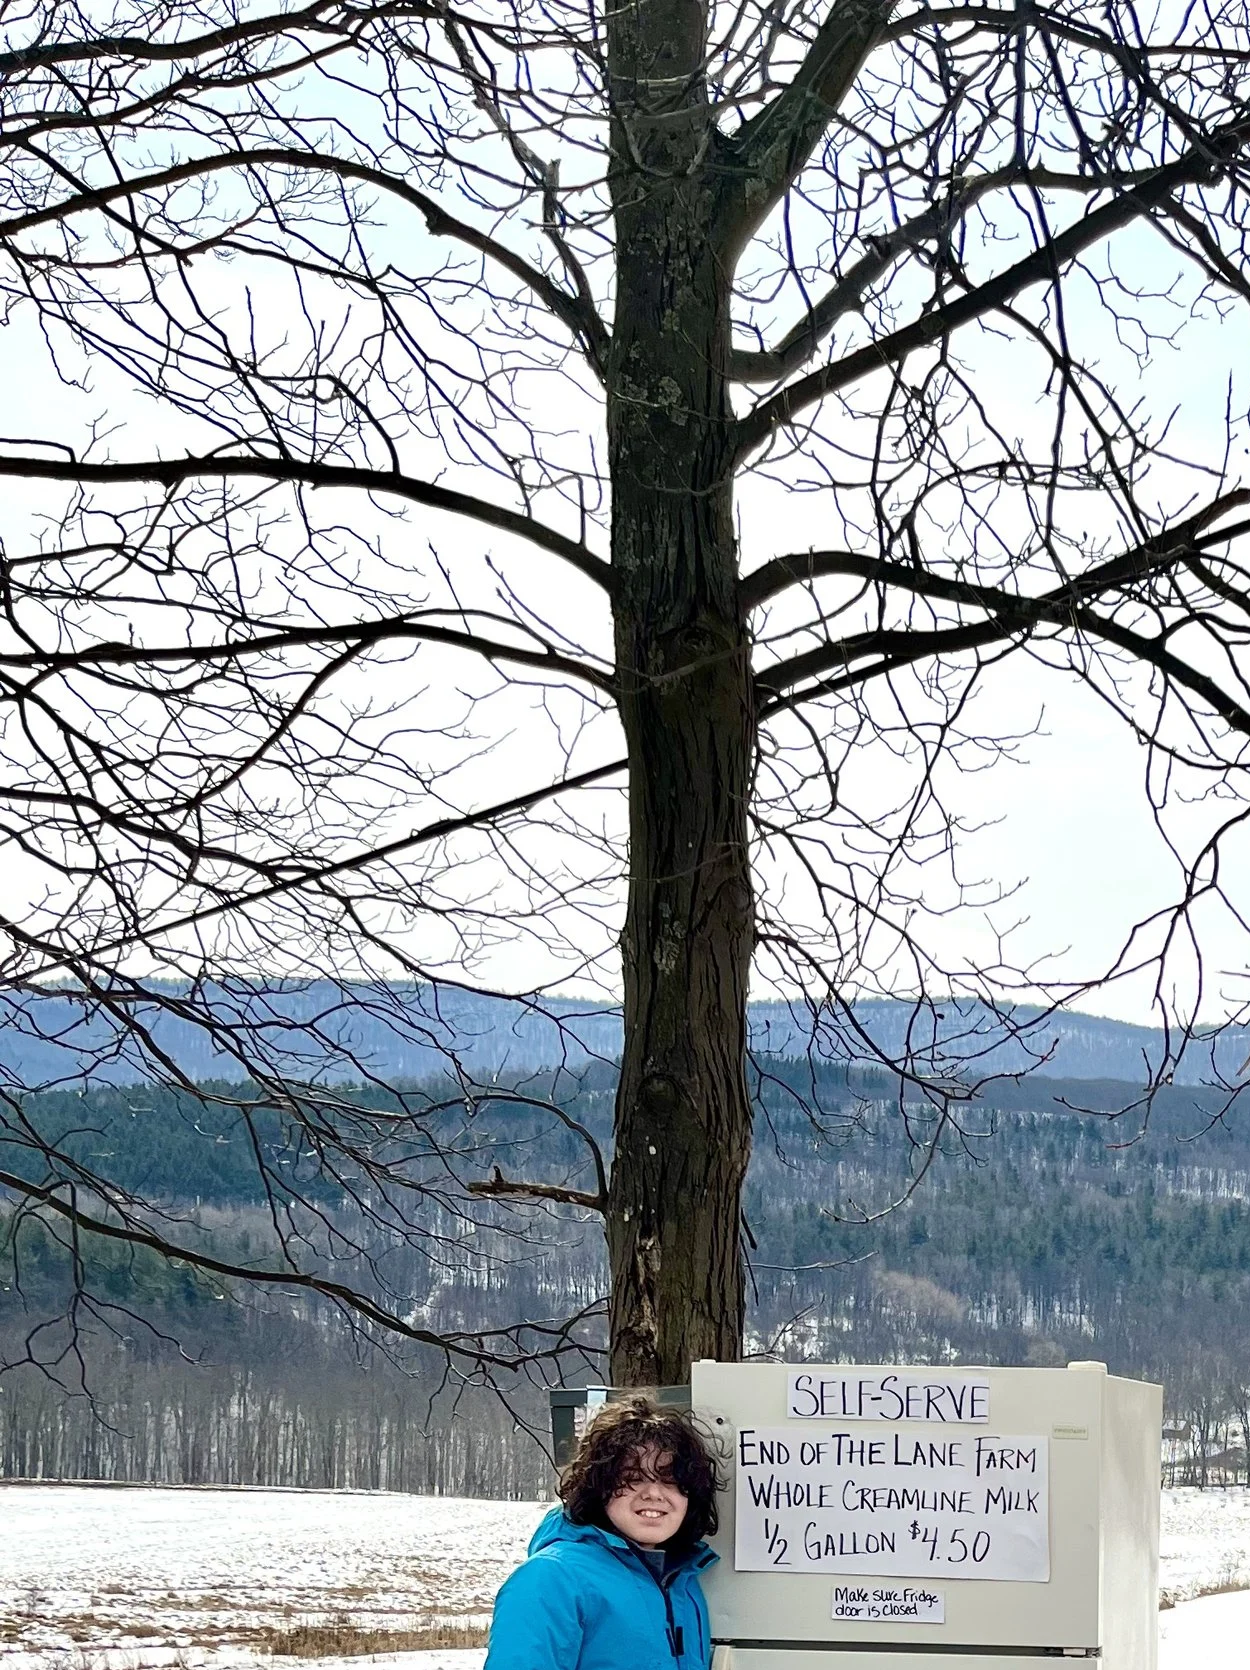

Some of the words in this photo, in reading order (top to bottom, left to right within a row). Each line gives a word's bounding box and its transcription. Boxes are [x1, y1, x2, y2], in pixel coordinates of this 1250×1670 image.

[792, 1375, 990, 1422] SELF-SERVE
[739, 1430, 790, 1467] END
[800, 1441, 829, 1466] OF
[832, 1433, 886, 1467] THE
[894, 1433, 966, 1468] LANE
[974, 1436, 1037, 1477] FARM
[748, 1474, 834, 1510] WHOLE
[842, 1479, 975, 1515] CREAMLINE
[985, 1486, 1040, 1515] MILK
[804, 1521, 896, 1561] GALLON
[908, 1519, 992, 1563] $4.50
[835, 1604, 864, 1617] door
[867, 1604, 881, 1618] is
[903, 1588, 939, 1608] Fridge
